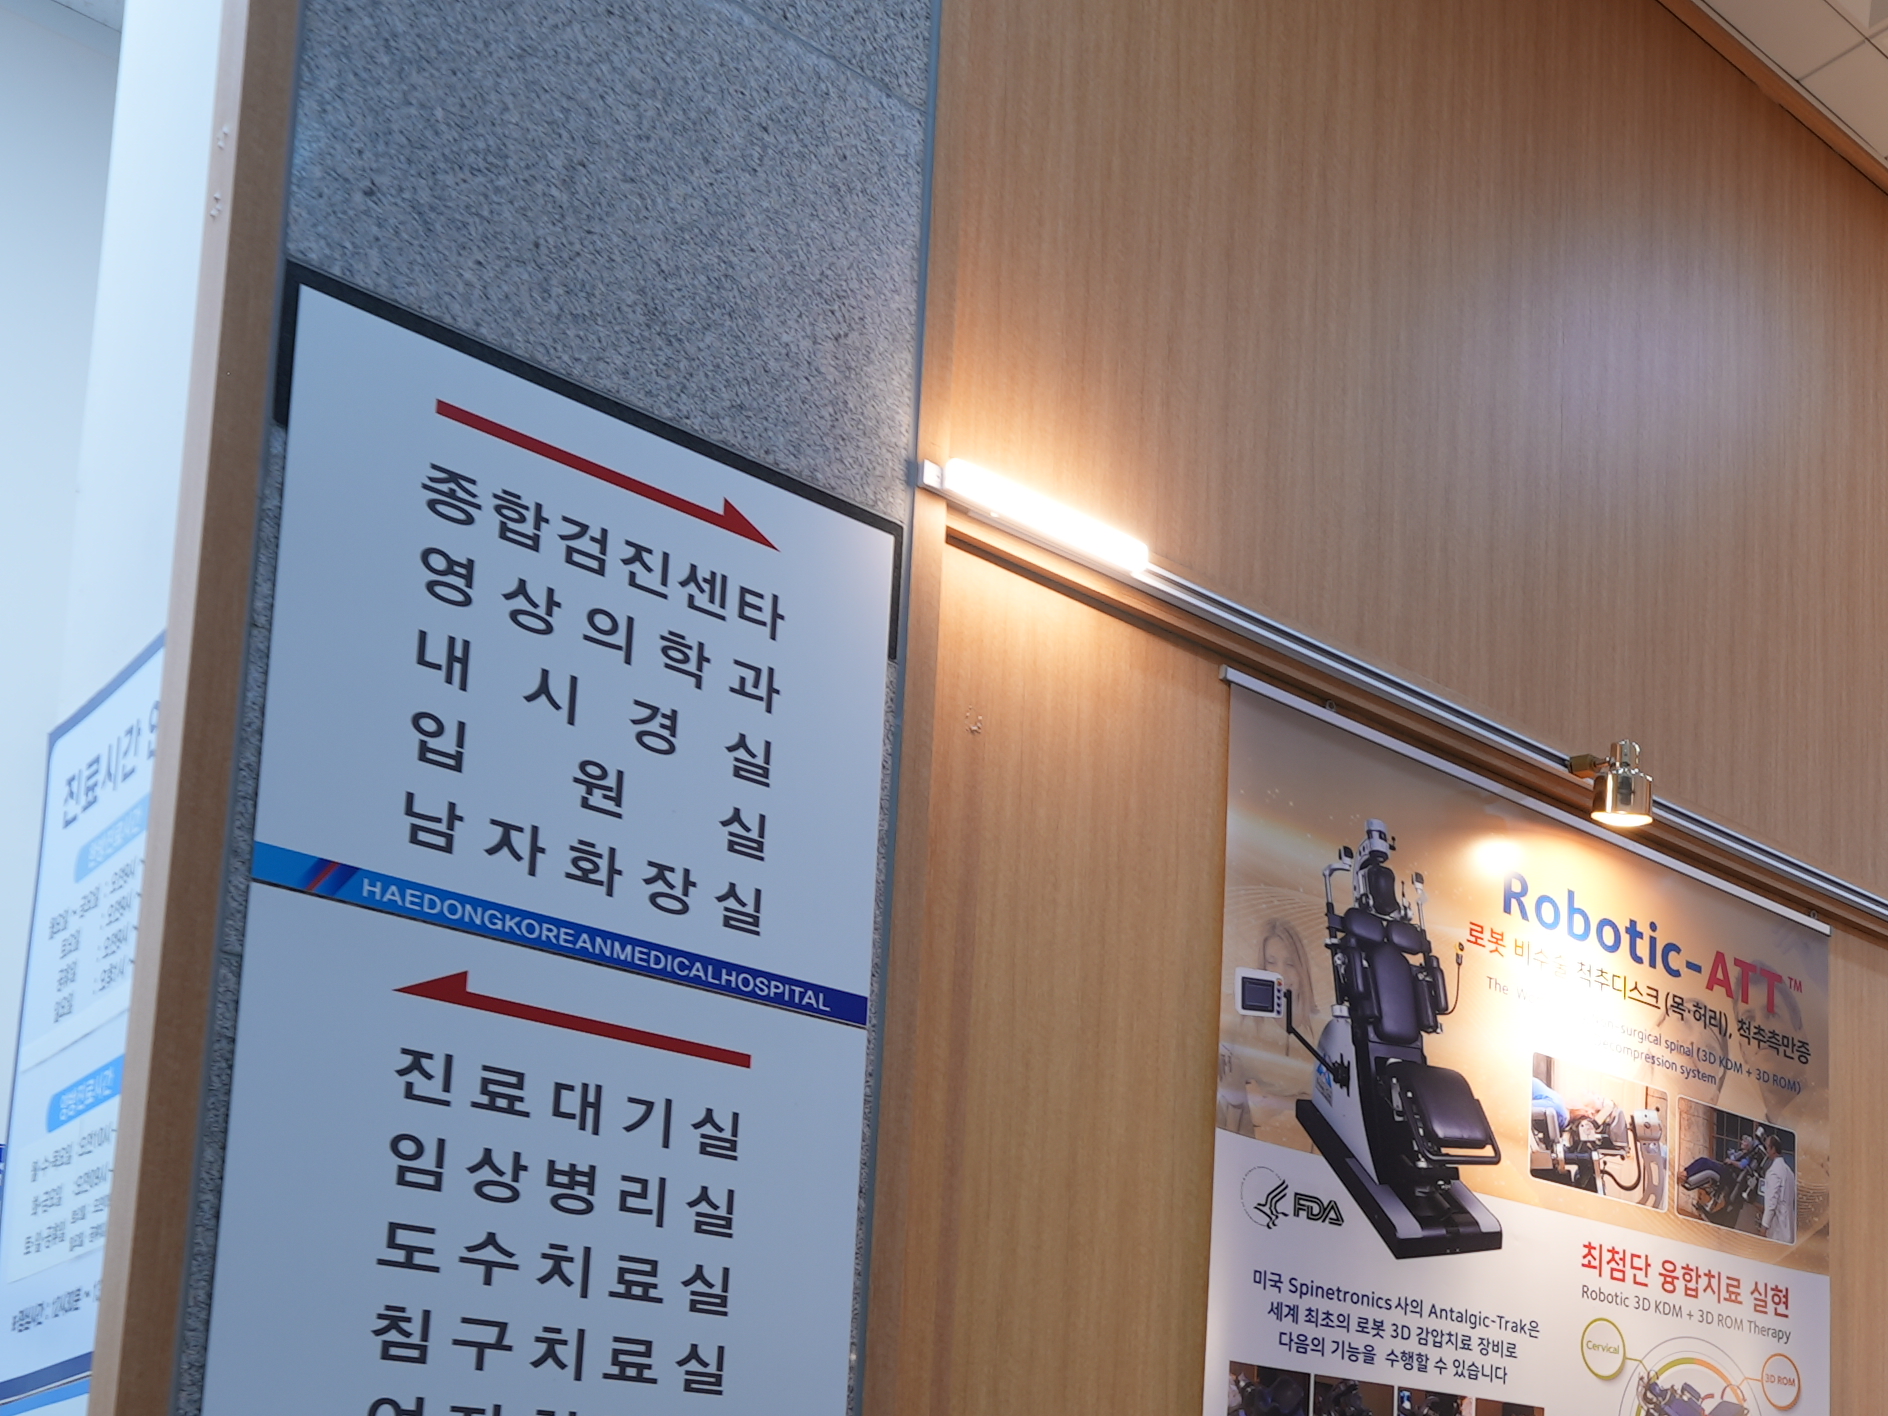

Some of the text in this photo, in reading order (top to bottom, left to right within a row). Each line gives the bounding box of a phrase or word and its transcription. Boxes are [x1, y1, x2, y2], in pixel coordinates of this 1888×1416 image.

[421, 462, 786, 640] 종합검진센타
[419, 546, 781, 712] 영상의학과
[61, 718, 143, 829] 진료시간
[404, 791, 761, 936] 남자화장실
[361, 876, 831, 1012] HAEDONGKOREANMEDICALHOSPITAL
[1467, 922, 1506, 957] 로봇
[1577, 962, 1660, 1010] 척추디스크
[1738, 1018, 1811, 1065] 척추측만증
[394, 1046, 741, 1161] 진료대기실
[1664, 1037, 1694, 1058] spinal
[1696, 1047, 1716, 1065] (3D
[1719, 1056, 1743, 1074] KDM
[1755, 1068, 1770, 1084] 3D
[1772, 1073, 1801, 1094] ROM)
[1680, 1065, 1717, 1086] system
[389, 1131, 738, 1239] 임상병리실
[1293, 1192, 1344, 1226] FDA
[376, 1221, 731, 1318] 도수치료실
[1253, 1269, 1284, 1294] 미국
[1428, 1303, 1540, 1338] Antalgic-Trak은
[1581, 1242, 1789, 1318] 최첨단 융합치료 실현
[371, 1303, 726, 1396] 침구치료실
[1268, 1301, 1518, 1359] 세계 최초의 로봇 3D 감압치료 장비로
[1582, 1285, 1791, 1344] Robotic 3D KDM 3D ROM Therapy
[1586, 1340, 1619, 1355] Cervical
[1279, 1331, 1508, 1385] 다음의 기능을 수행할 수 있습니다
[1765, 1373, 1796, 1387] 3D ROM
